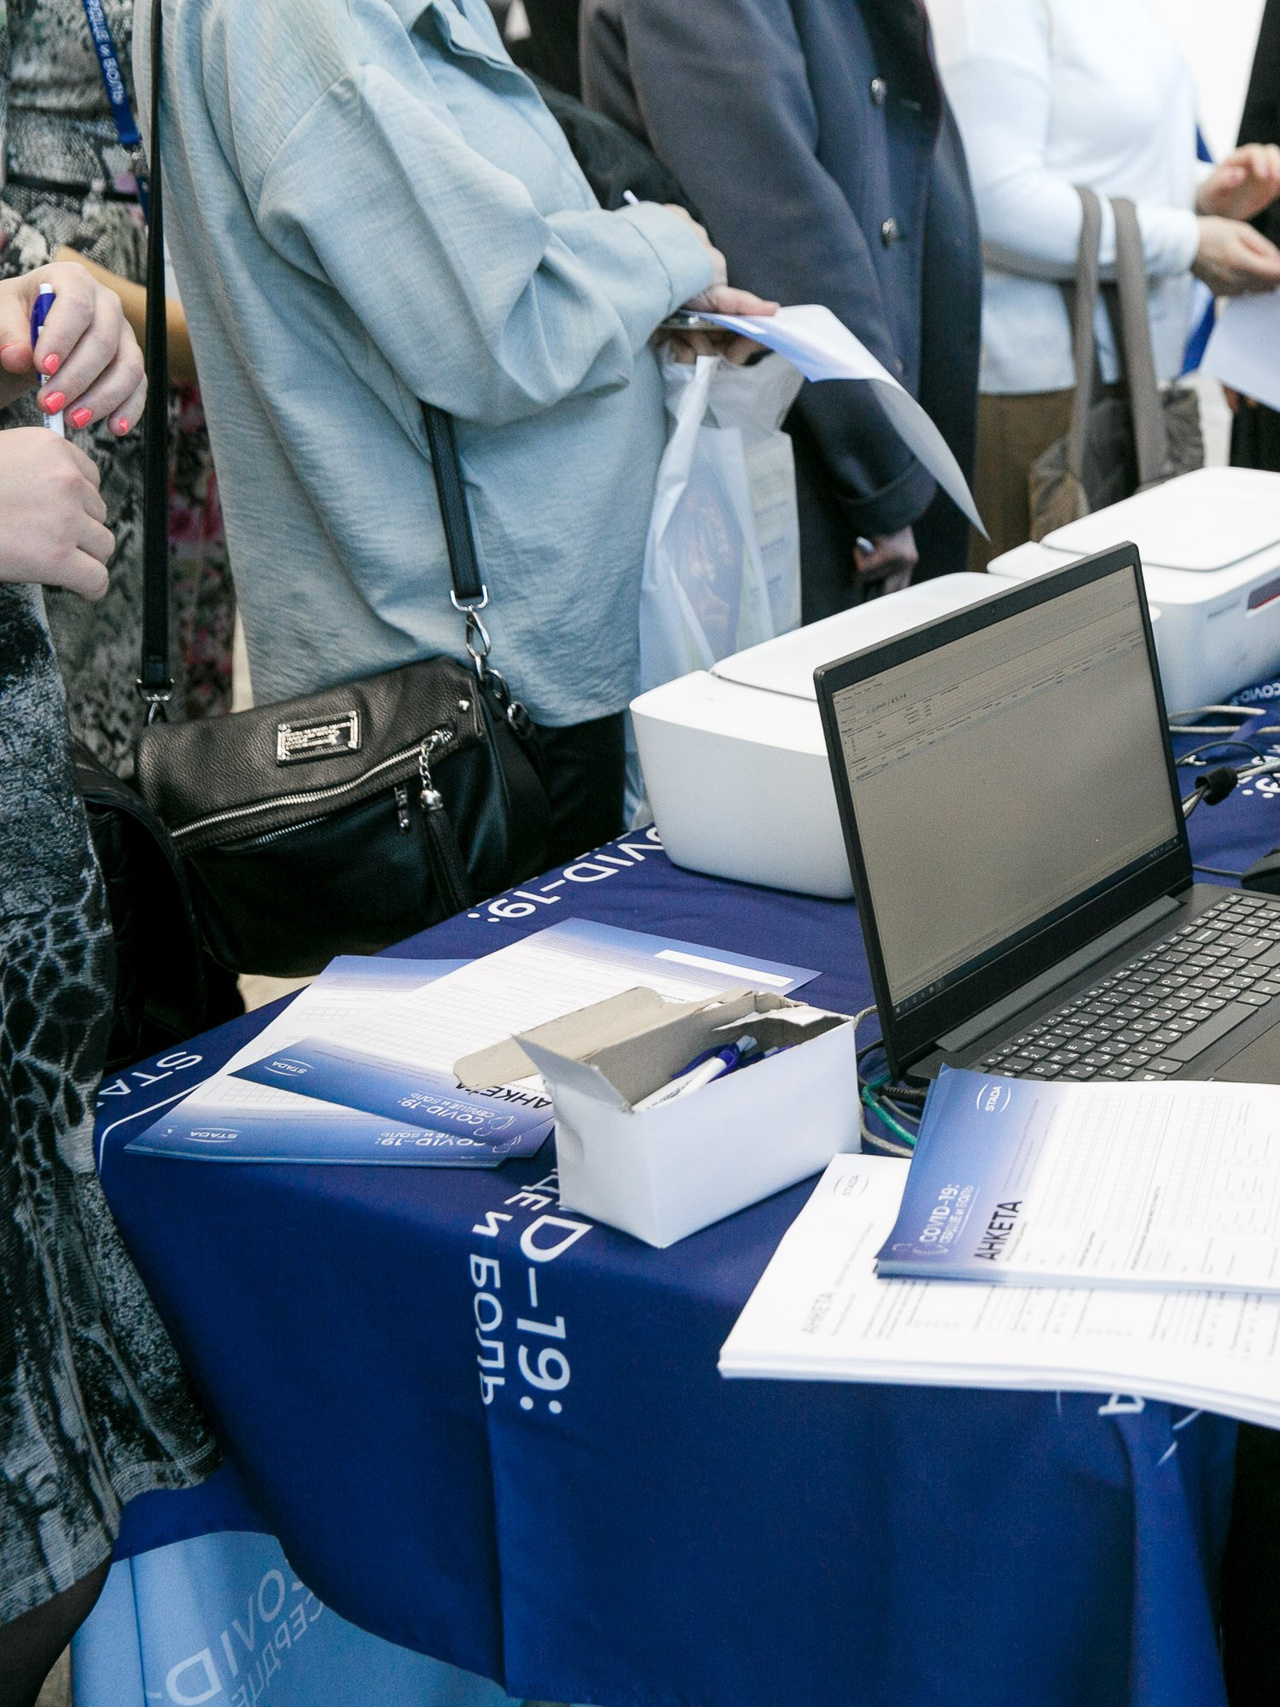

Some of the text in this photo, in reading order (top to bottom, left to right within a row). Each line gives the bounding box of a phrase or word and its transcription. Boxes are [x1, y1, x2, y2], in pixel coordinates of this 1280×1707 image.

[97, 1051, 203, 1108] STA
[272, 1060, 308, 1075] STADA
[397, 1097, 484, 1126] COVID-19:
[450, 1101, 496, 1119] СЕРДЦЕ
[985, 1085, 1003, 1113] STADA
[190, 1130, 239, 1140] STADA
[918, 1183, 961, 1244] COVID-19:
[974, 1201, 1023, 1262] АНКЕТА
[469, 1253, 506, 1406] БОЛЬ
